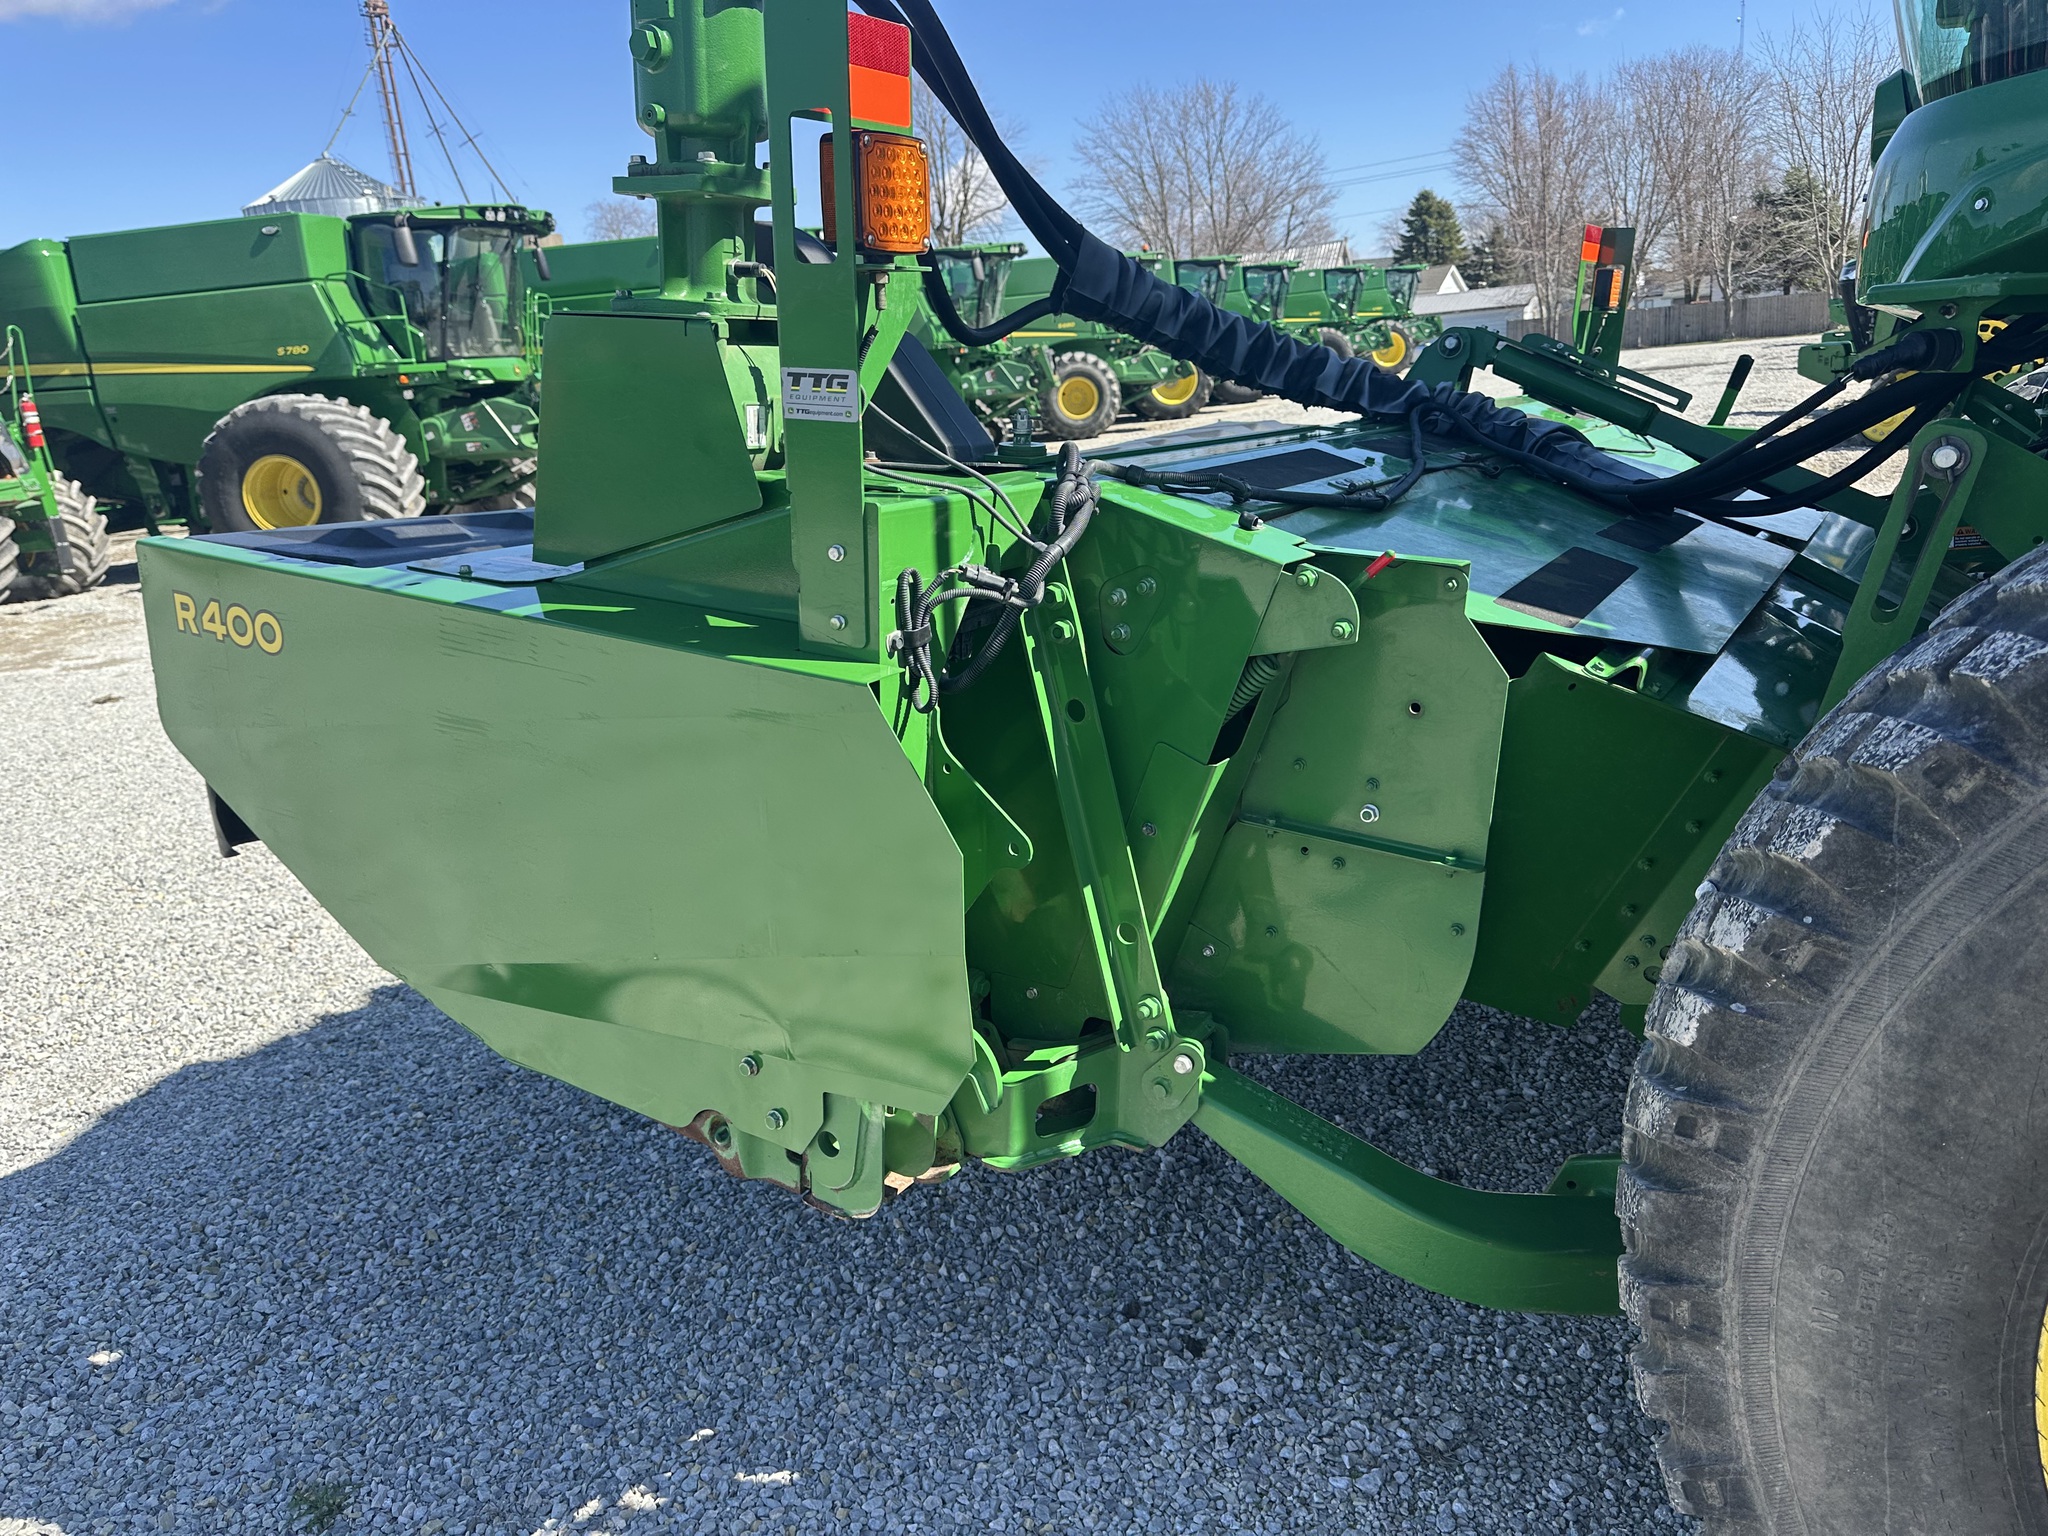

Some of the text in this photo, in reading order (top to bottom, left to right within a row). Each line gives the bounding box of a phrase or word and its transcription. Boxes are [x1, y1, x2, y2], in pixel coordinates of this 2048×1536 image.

[276, 344, 310, 357] S780
[786, 372, 850, 394] TTG
[789, 394, 847, 402] EQUIPMENT
[796, 408, 844, 417] TTGequipment.com
[172, 589, 284, 656] R400
